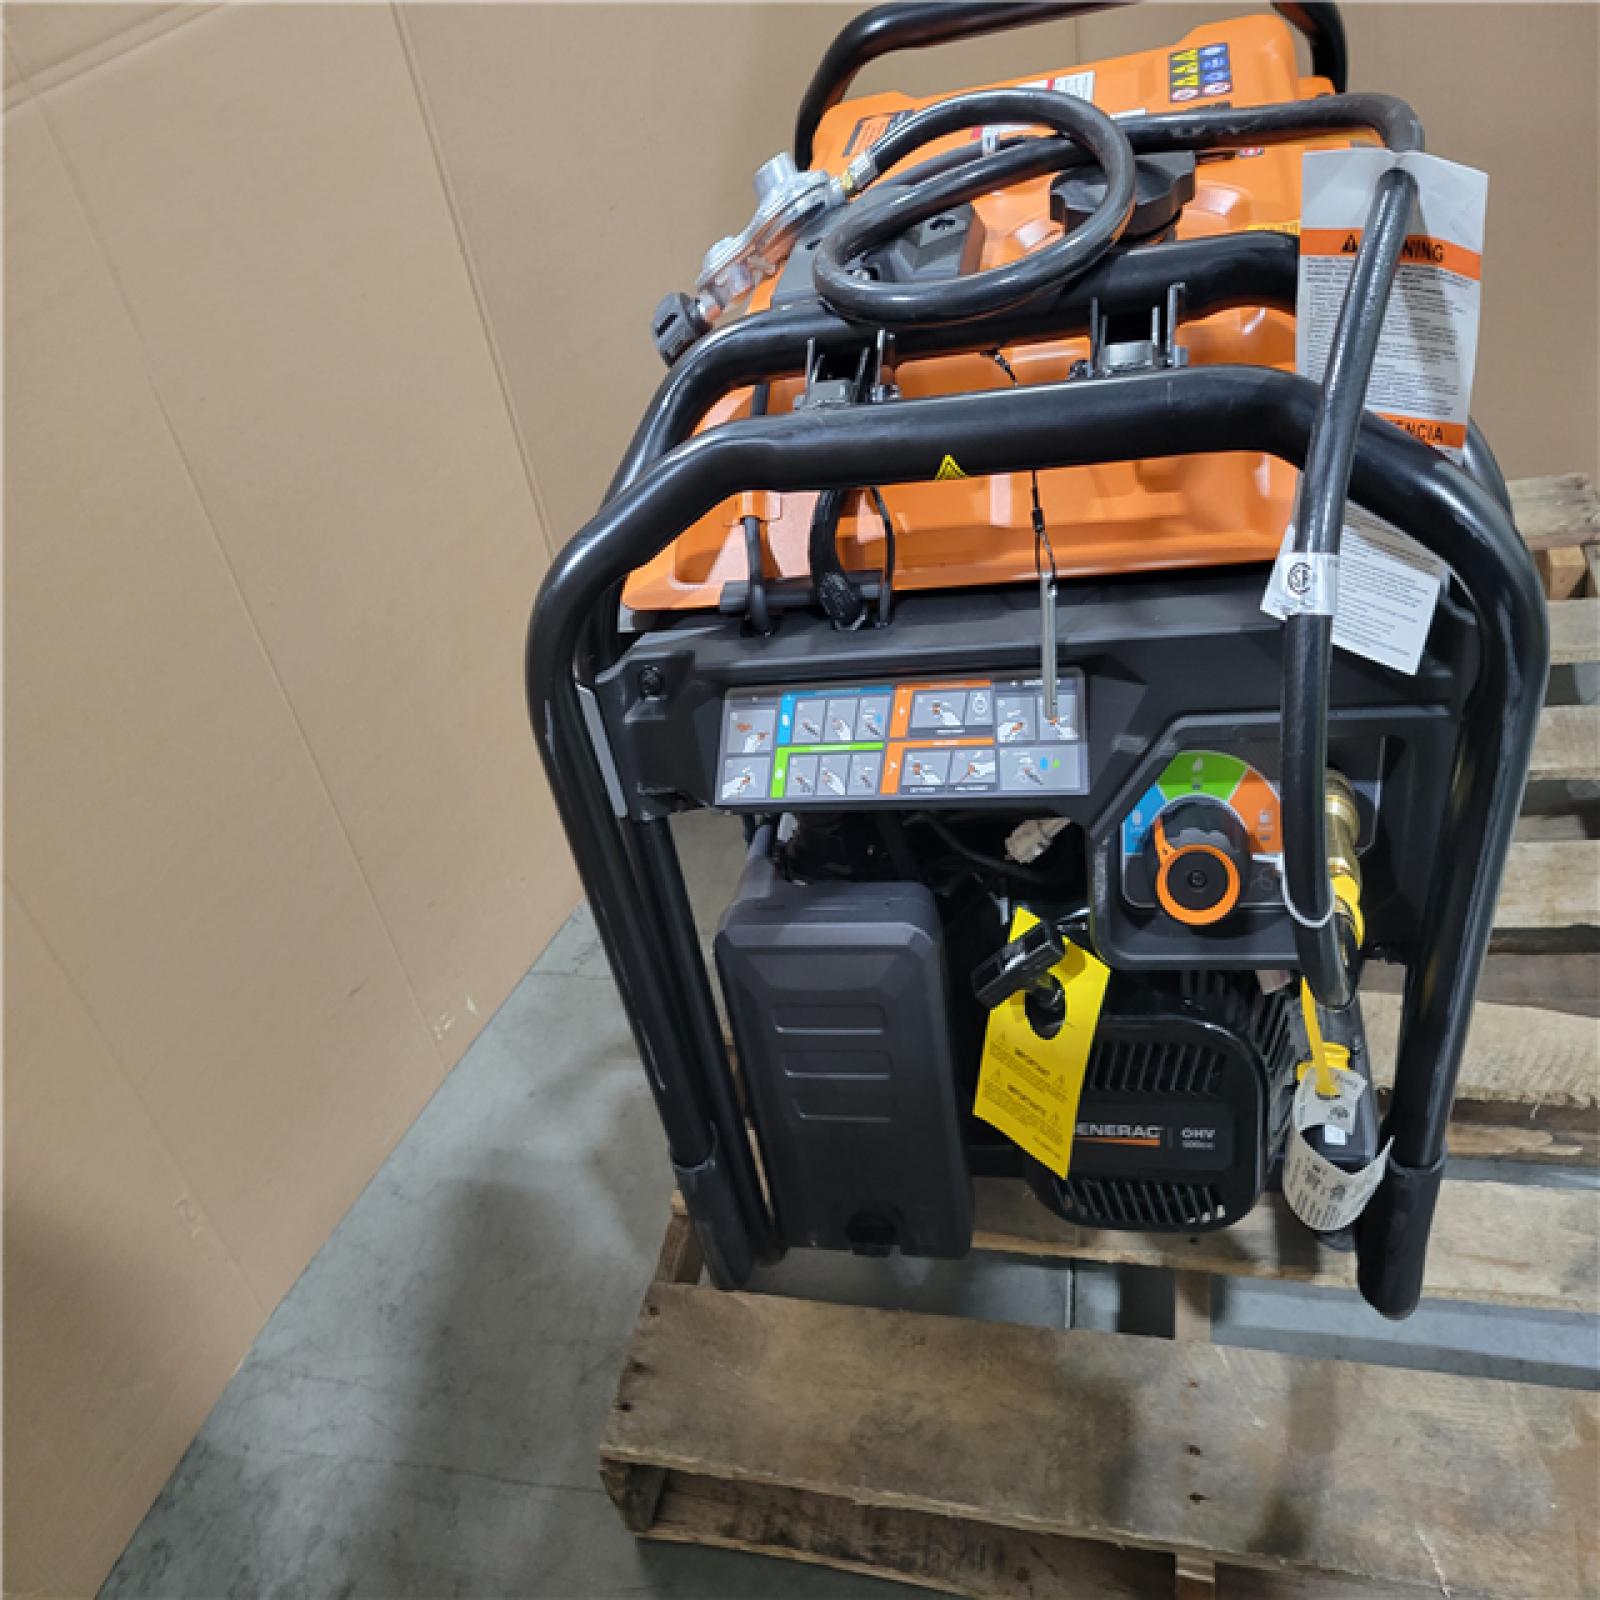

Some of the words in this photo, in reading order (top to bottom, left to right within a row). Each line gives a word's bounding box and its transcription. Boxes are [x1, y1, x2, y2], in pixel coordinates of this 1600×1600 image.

[1402, 239, 1444, 263] NING
[1074, 1122, 1162, 1138] ENERAC
[1181, 1127, 1216, 1139] OHV
